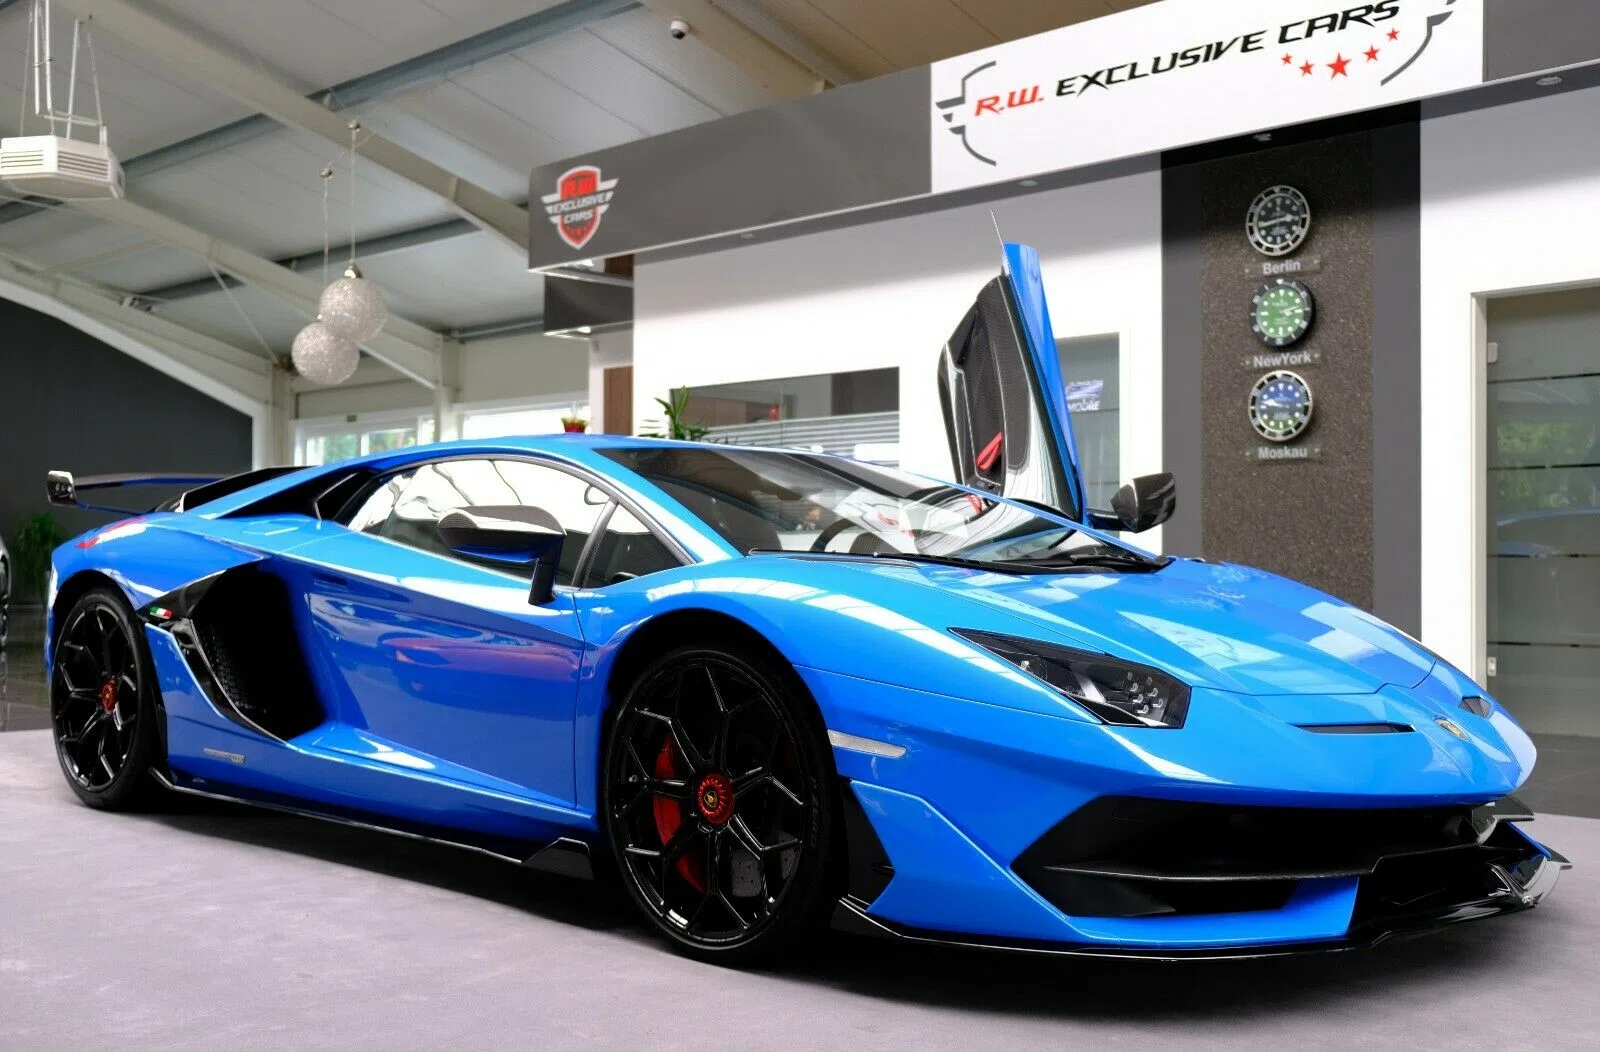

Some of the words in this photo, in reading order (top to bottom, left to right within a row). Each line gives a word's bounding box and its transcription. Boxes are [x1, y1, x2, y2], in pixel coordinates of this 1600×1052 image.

[975, 85, 1044, 116] R.W.
[1055, 30, 1267, 97] EXCLUSIVE
[1277, 0, 1400, 44] CARS
[552, 192, 606, 214] EXCLUSIVE
[563, 209, 594, 225] CARS
[1262, 259, 1302, 276] Berlin
[1253, 350, 1312, 369] NewYork
[1257, 445, 1308, 460] Moskau
